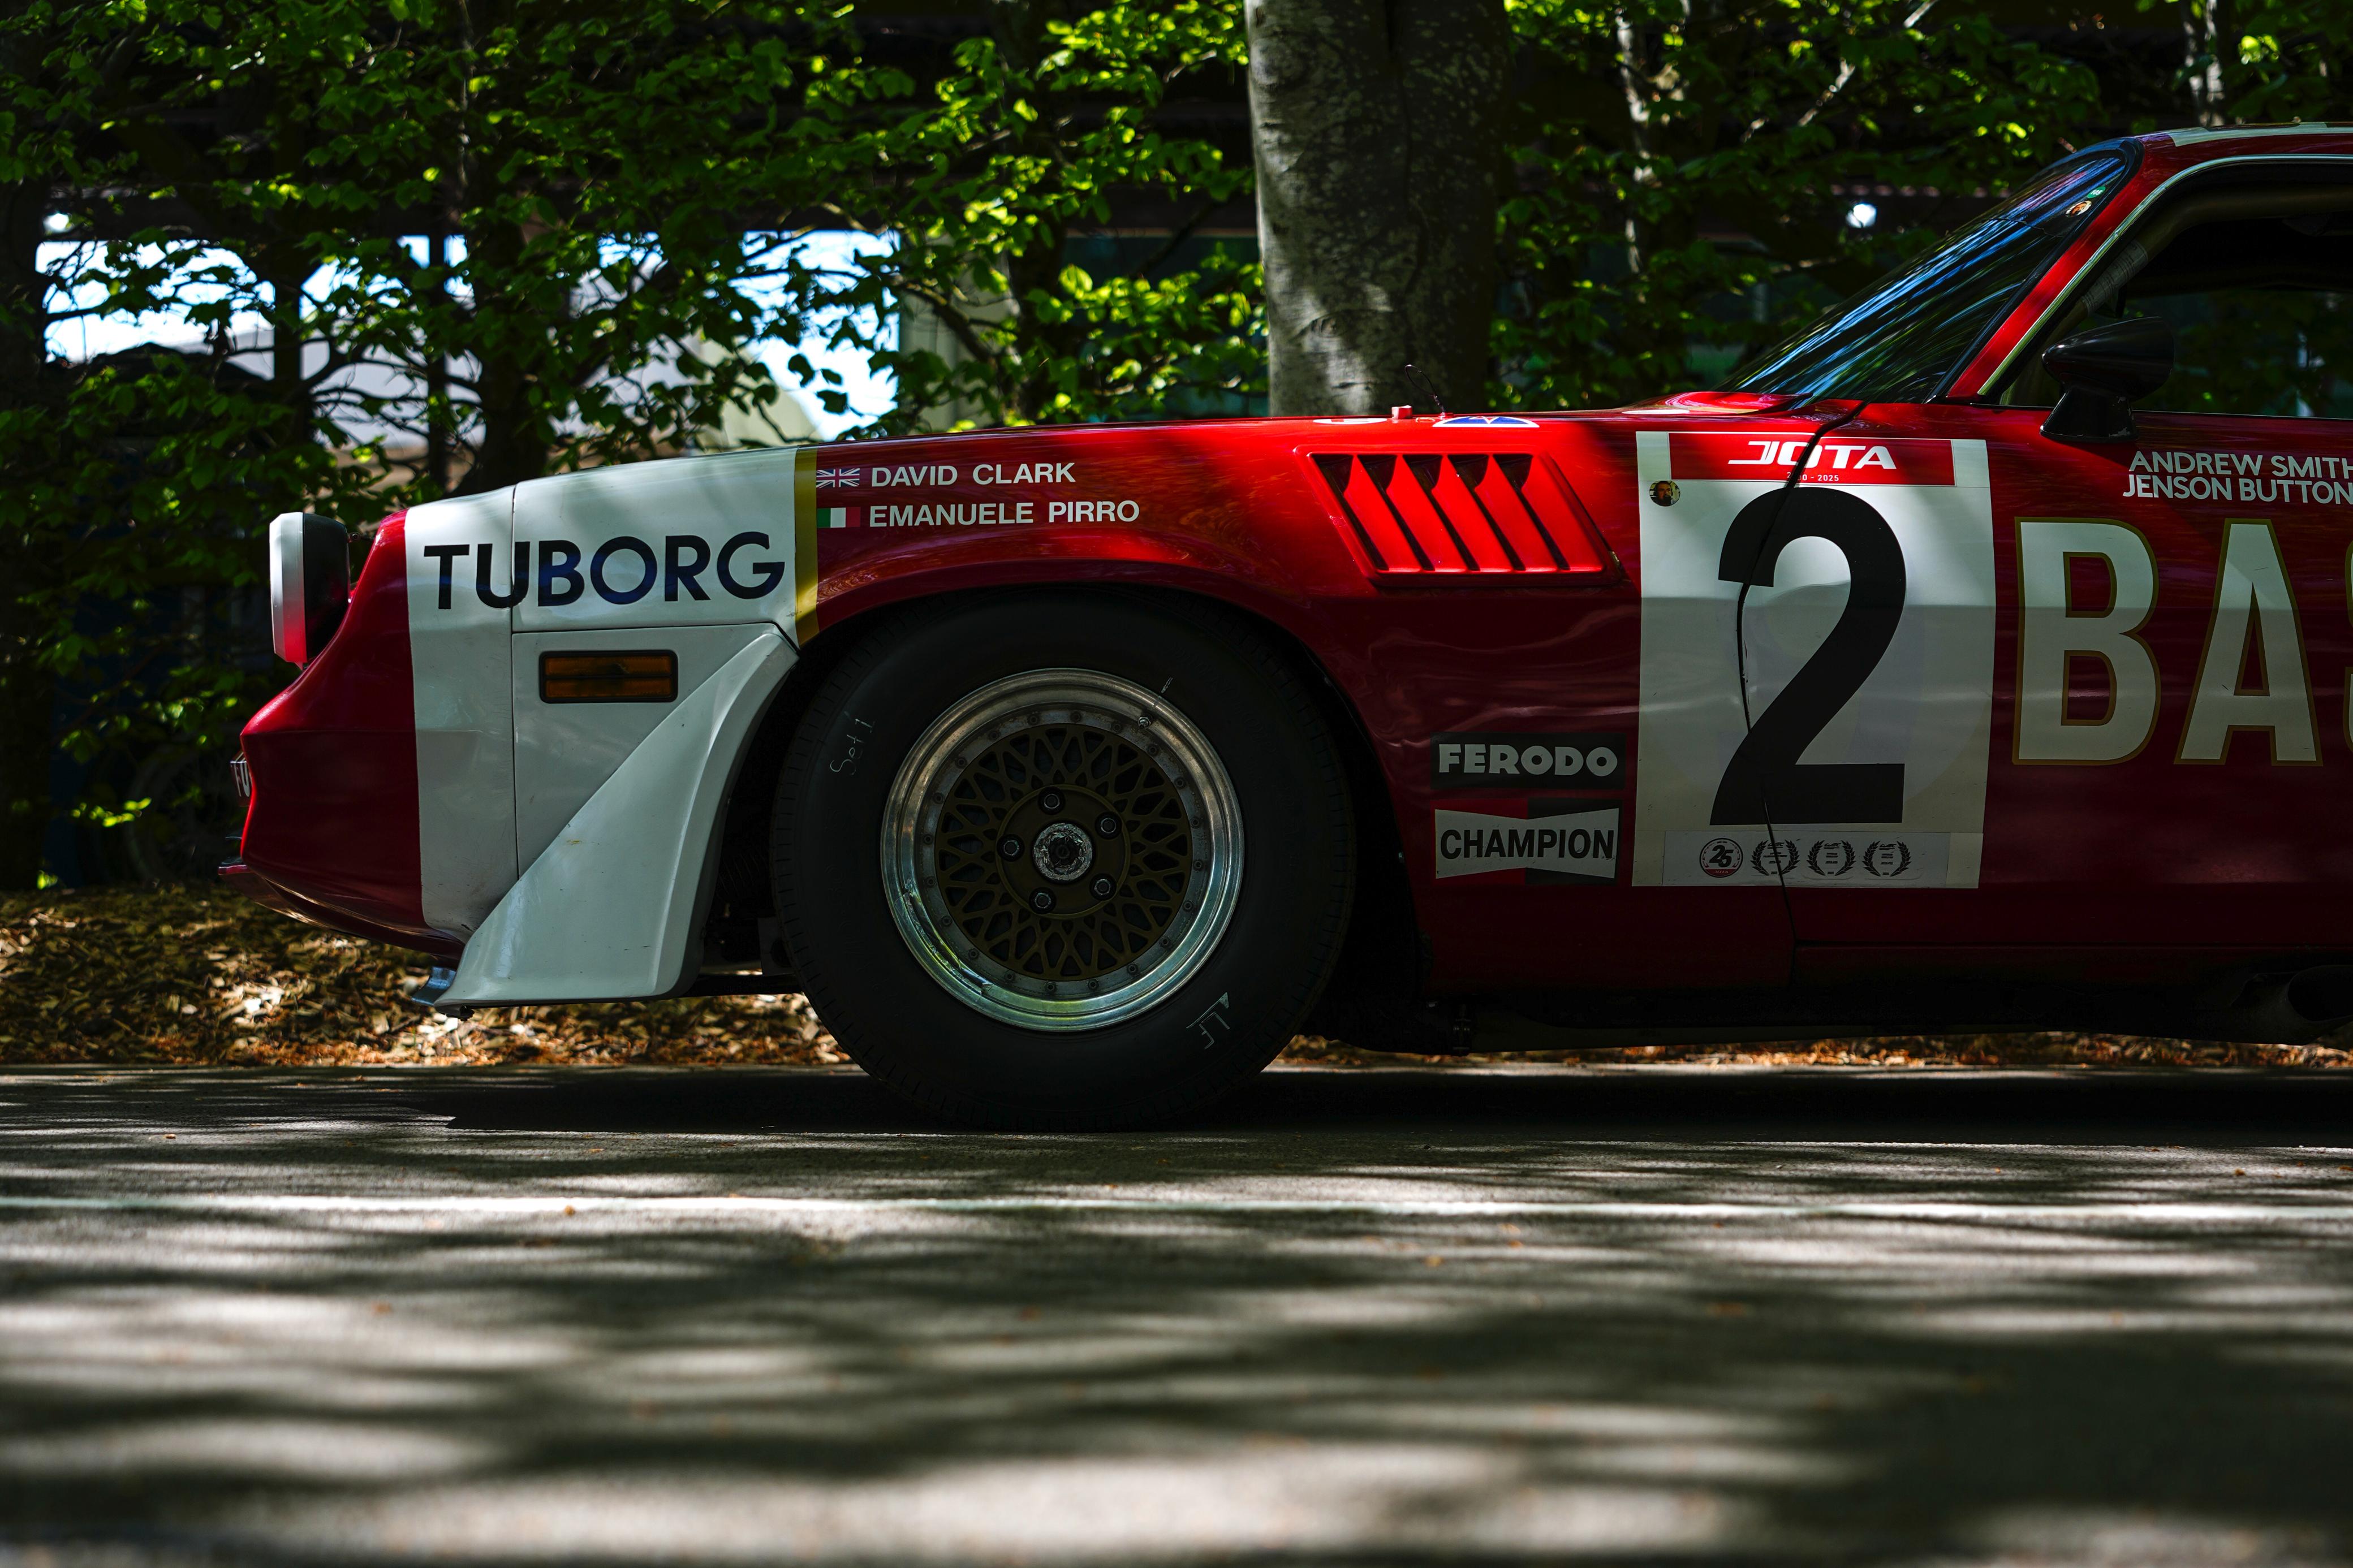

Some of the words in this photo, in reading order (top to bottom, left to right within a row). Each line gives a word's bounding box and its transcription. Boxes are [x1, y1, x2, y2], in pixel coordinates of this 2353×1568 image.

[1728, 441, 1897, 470] JOTA
[2129, 451, 2262, 476] ANDREW
[871, 465, 958, 487] DAVID
[973, 463, 1076, 485] CLARK
[2123, 475, 2232, 501] JENSON
[2240, 478, 2353, 505] BUTTON
[869, 502, 1034, 527] EMANUELE
[1049, 500, 1140, 524] PIRRO
[424, 531, 785, 610] TUBORG
[1710, 487, 1906, 825] 2
[2011, 516, 2353, 767] BA
[830, 734, 864, 775] Set
[1438, 743, 1618, 777] FERODO
[1440, 828, 1614, 859] CHAMPION
[1709, 845, 1734, 867] 25
